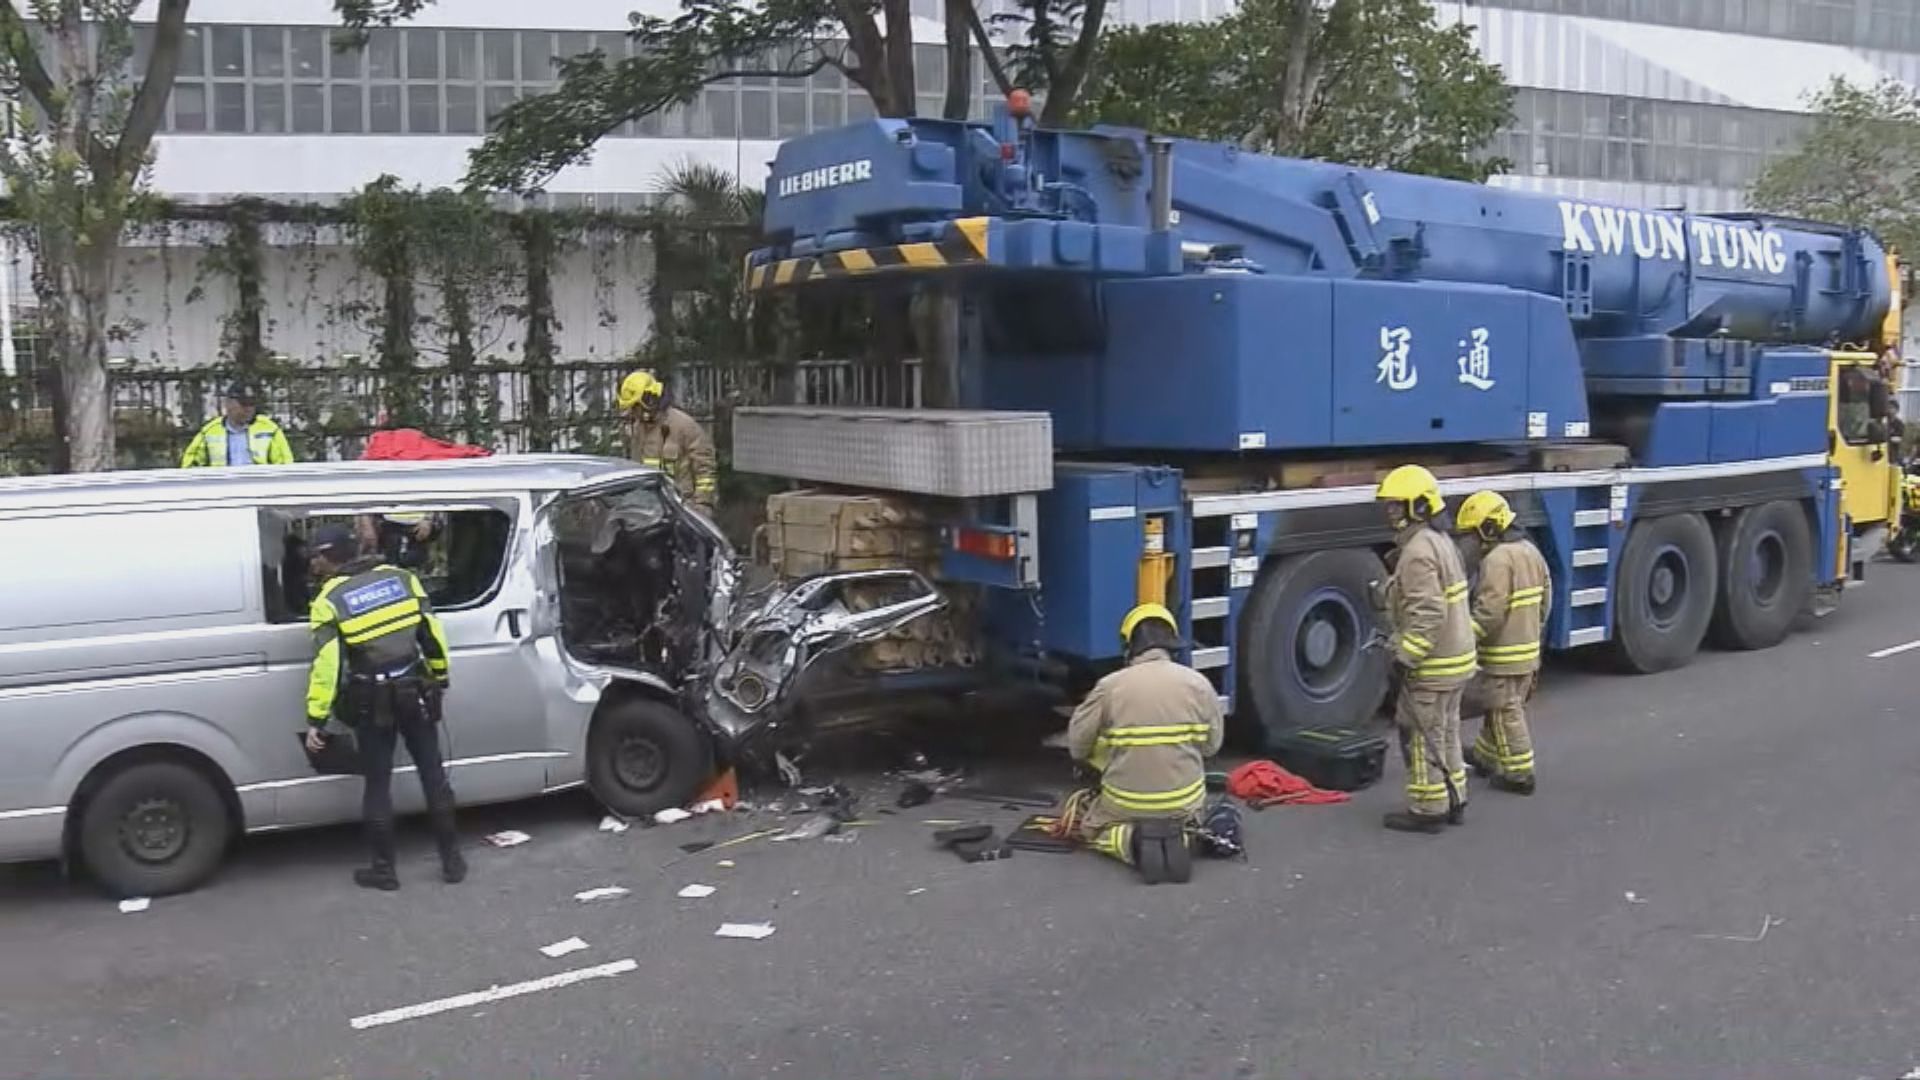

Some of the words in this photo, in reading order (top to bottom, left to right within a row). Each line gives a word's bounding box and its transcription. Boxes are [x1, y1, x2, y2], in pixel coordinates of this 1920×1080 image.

[779, 159, 872, 197] LIEBHERR
[1558, 201, 1686, 261] KWUN
[1691, 220, 1787, 274] TUNG
